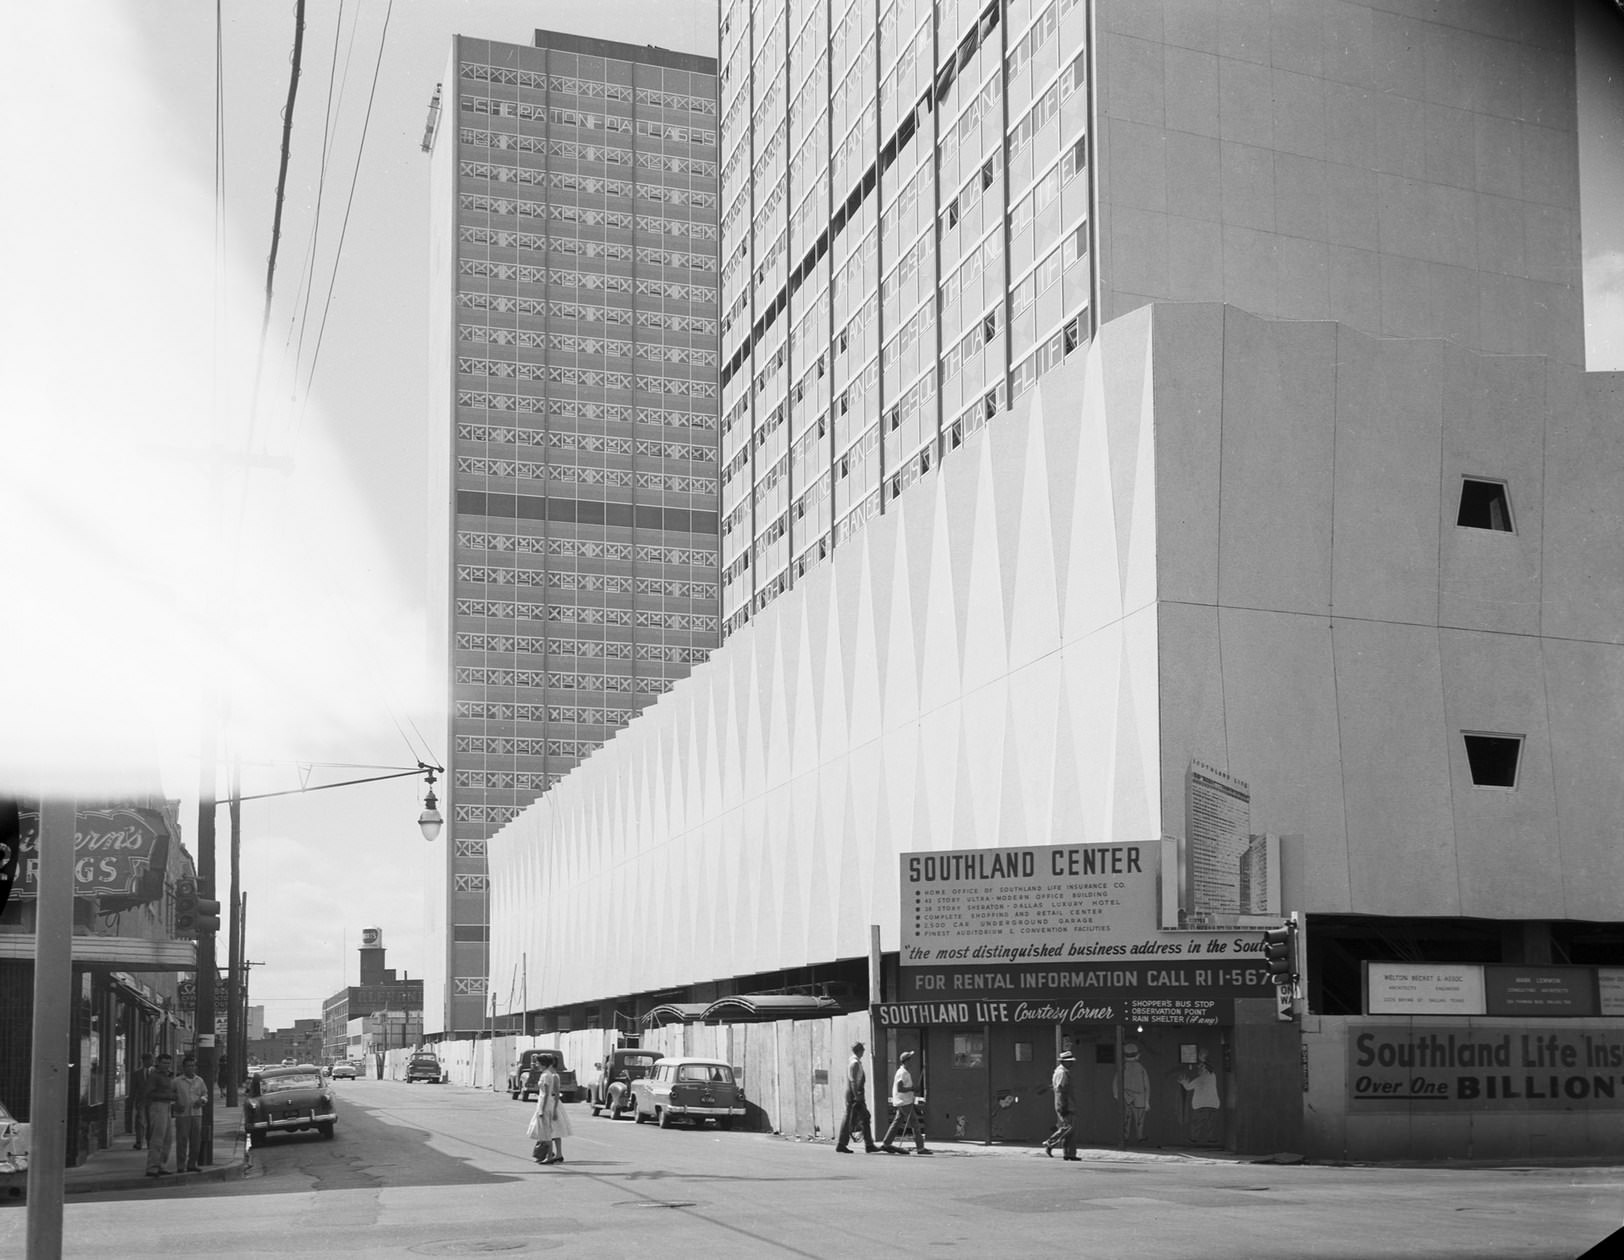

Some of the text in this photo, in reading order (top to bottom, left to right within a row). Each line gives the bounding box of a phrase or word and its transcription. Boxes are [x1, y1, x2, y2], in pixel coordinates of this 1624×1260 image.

[909, 847, 1142, 882] SOUTHLAND CENTER
[1000, 885, 1042, 893] SOUTHLAND
[937, 896, 960, 904] STORY
[956, 928, 1003, 936] AUDITORIUM
[1020, 926, 1068, 934] CONVENTION
[980, 918, 1048, 927] UNDERGROUND
[935, 946, 970, 959] most
[972, 942, 1064, 962] distinguished
[1068, 942, 1126, 957] business
[1130, 940, 1182, 955] address
[1187, 939, 1201, 954] in
[1206, 938, 1227, 953] the
[1233, 938, 1266, 953] Sout
[915, 969, 1268, 990] FOR RENTAL INFORMATION CALL RI 1-567
[880, 1000, 1114, 1025] SOUTHLAND LIFE Courtesy Corner
[1151, 1015, 1184, 1023] SHELTER
[1356, 1032, 1624, 1068] Southland Life Ins
[1355, 1075, 1615, 1100] Over One BILLION
